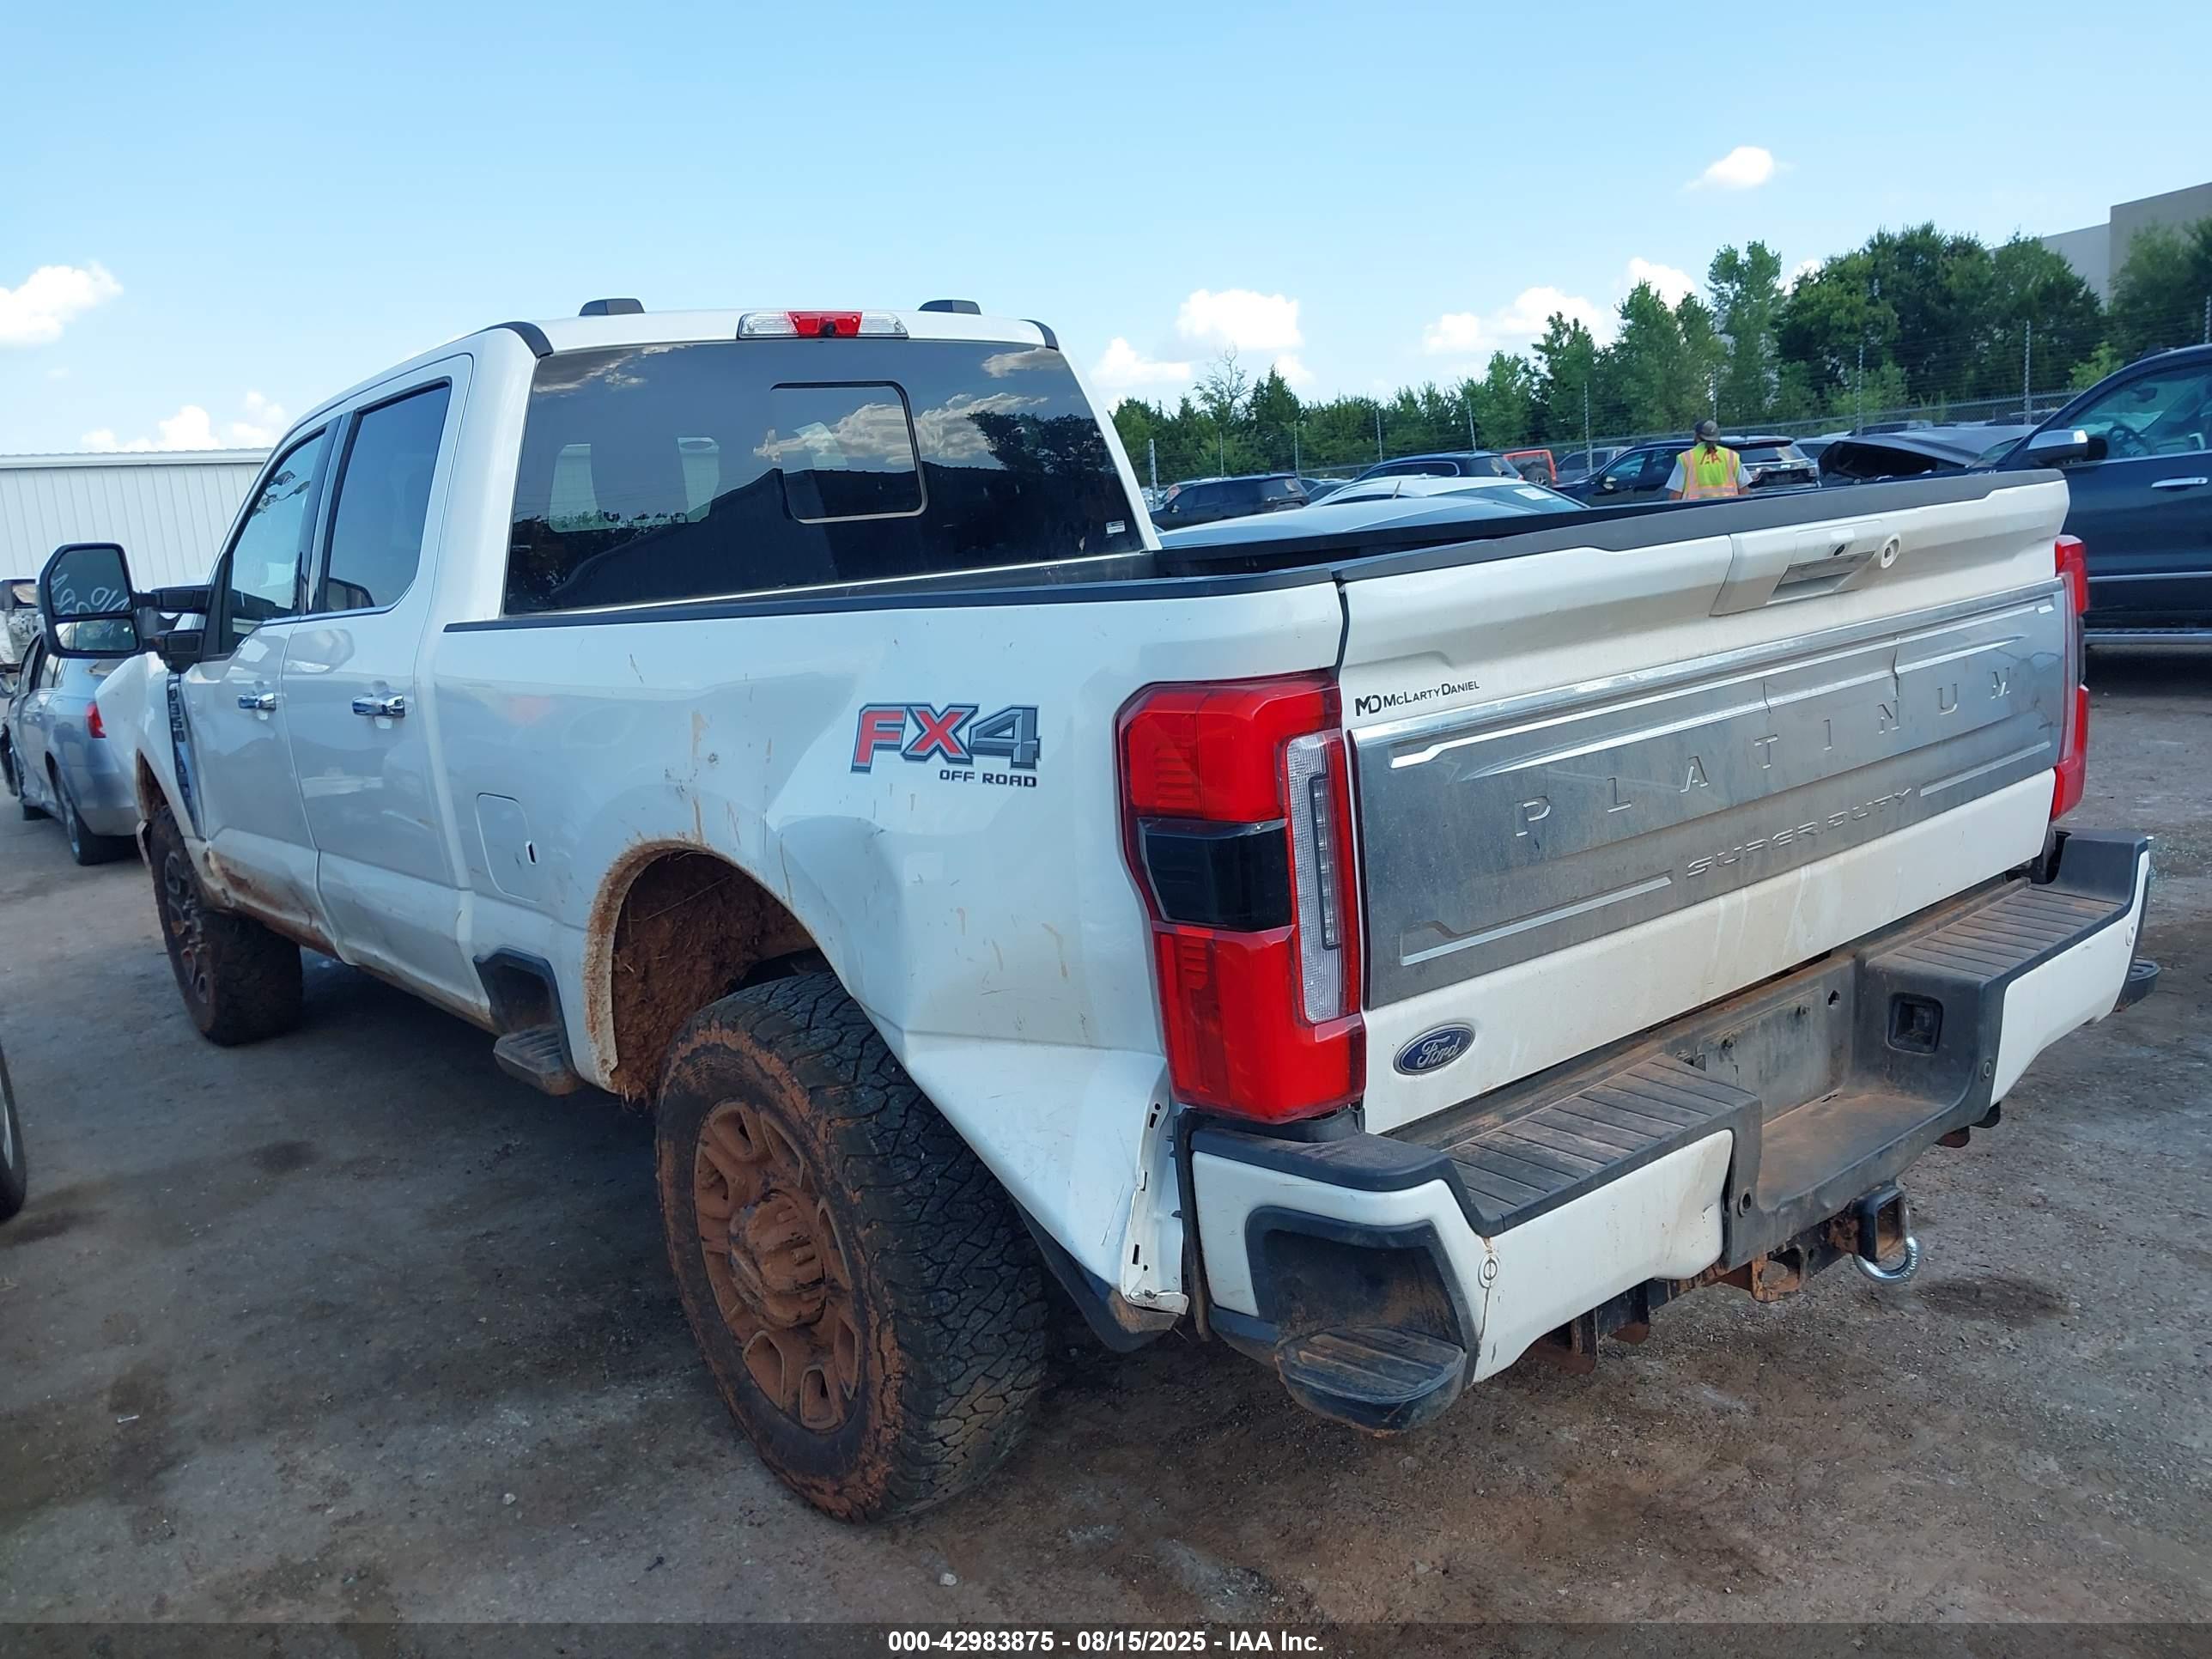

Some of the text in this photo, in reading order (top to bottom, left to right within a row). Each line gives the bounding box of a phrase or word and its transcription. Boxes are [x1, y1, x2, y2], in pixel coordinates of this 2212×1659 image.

[850, 702, 1042, 775] FX4
[1515, 665, 2010, 837] PLATINUM
[939, 769, 1037, 787] OFF ROAD
[1687, 787, 1912, 877] SUPER DUTY
[1416, 1035, 1461, 1068] Ford
